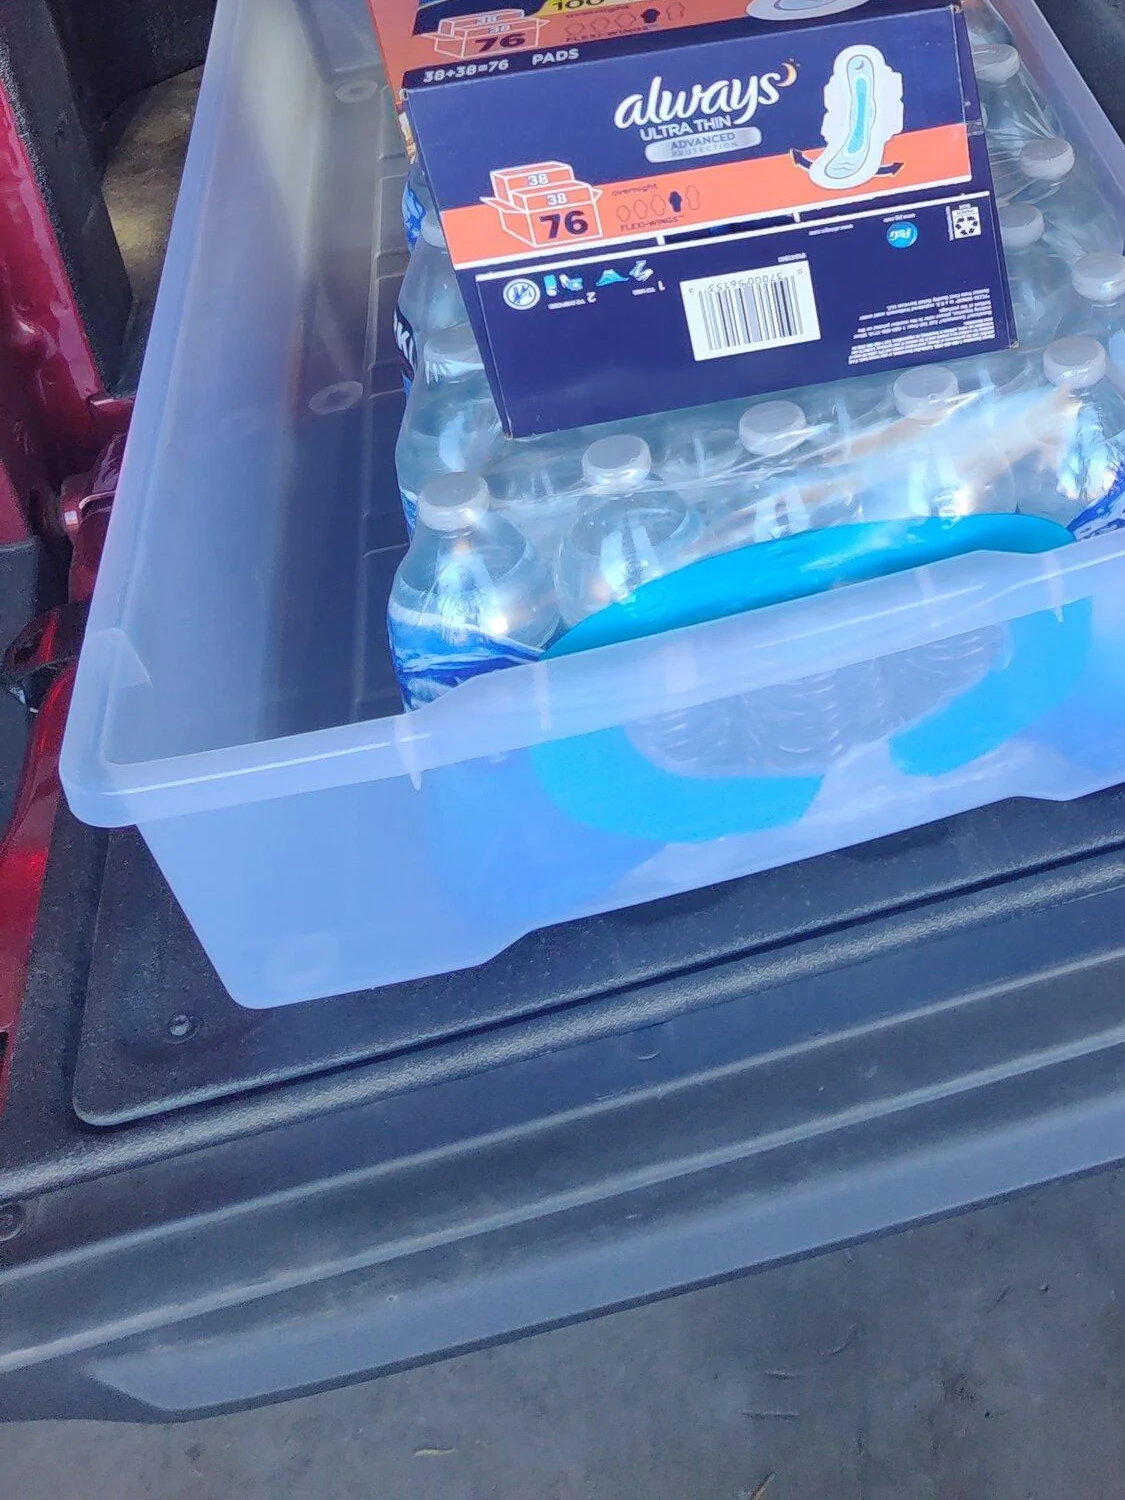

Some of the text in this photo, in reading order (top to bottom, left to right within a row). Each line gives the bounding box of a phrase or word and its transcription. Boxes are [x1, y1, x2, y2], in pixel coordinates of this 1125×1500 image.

[474, 33, 525, 52] 76
[423, 48, 580, 83] 38+38=76 PADS
[614, 73, 782, 129] always
[640, 114, 732, 141] ULTRA THIN
[670, 133, 735, 150] ADVANCED
[527, 173, 549, 186] 38
[612, 183, 658, 196] overnight
[546, 193, 567, 206] 38
[539, 210, 588, 239] 76
[587, 291, 597, 303] 2
